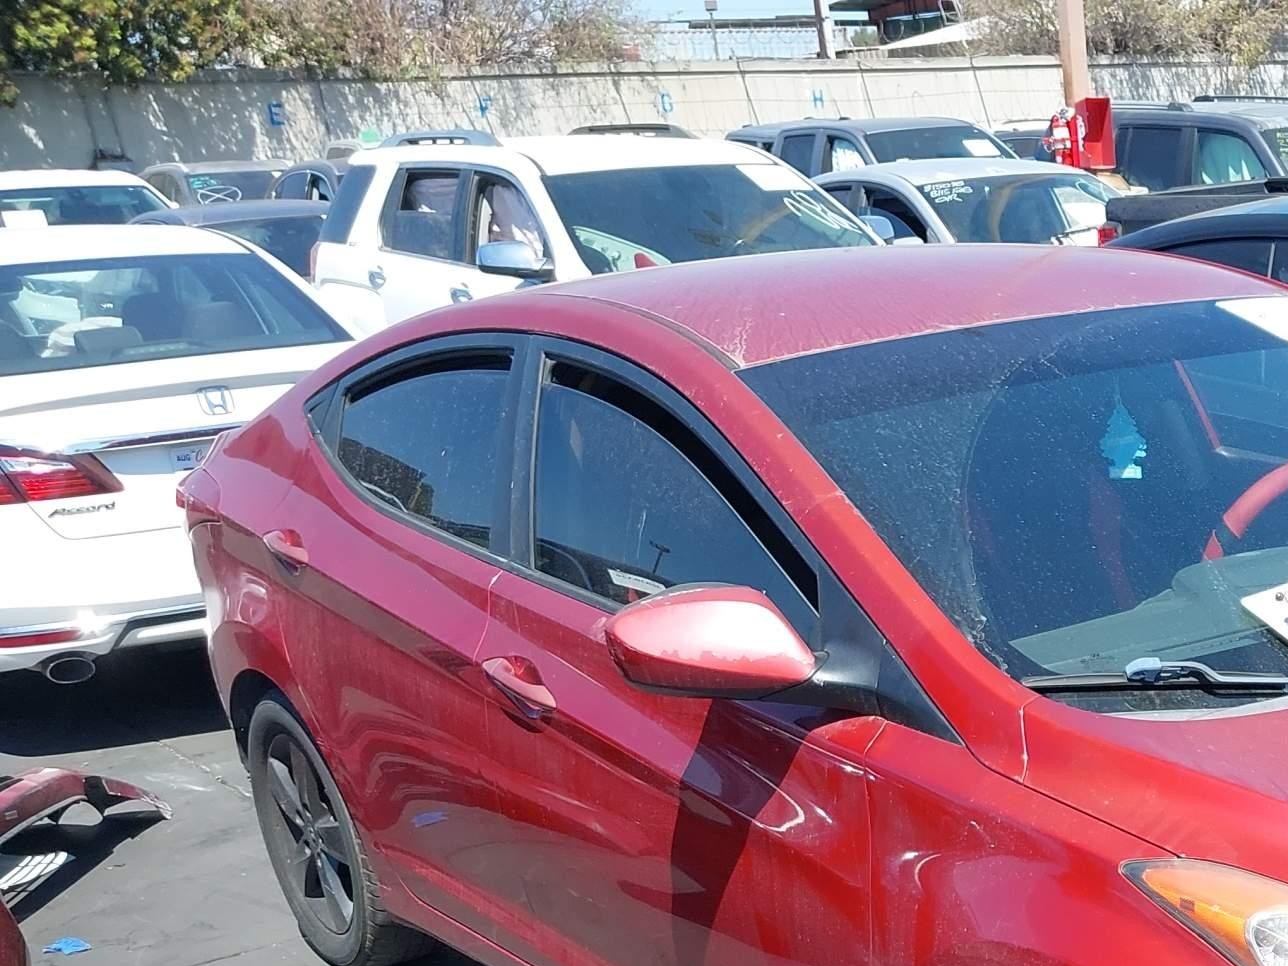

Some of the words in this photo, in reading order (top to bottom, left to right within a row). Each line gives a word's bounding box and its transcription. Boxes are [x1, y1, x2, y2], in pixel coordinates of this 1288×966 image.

[660, 90, 673, 112] G
[812, 88, 824, 109] H
[268, 103, 284, 126] E
[48, 500, 116, 518] Accord
